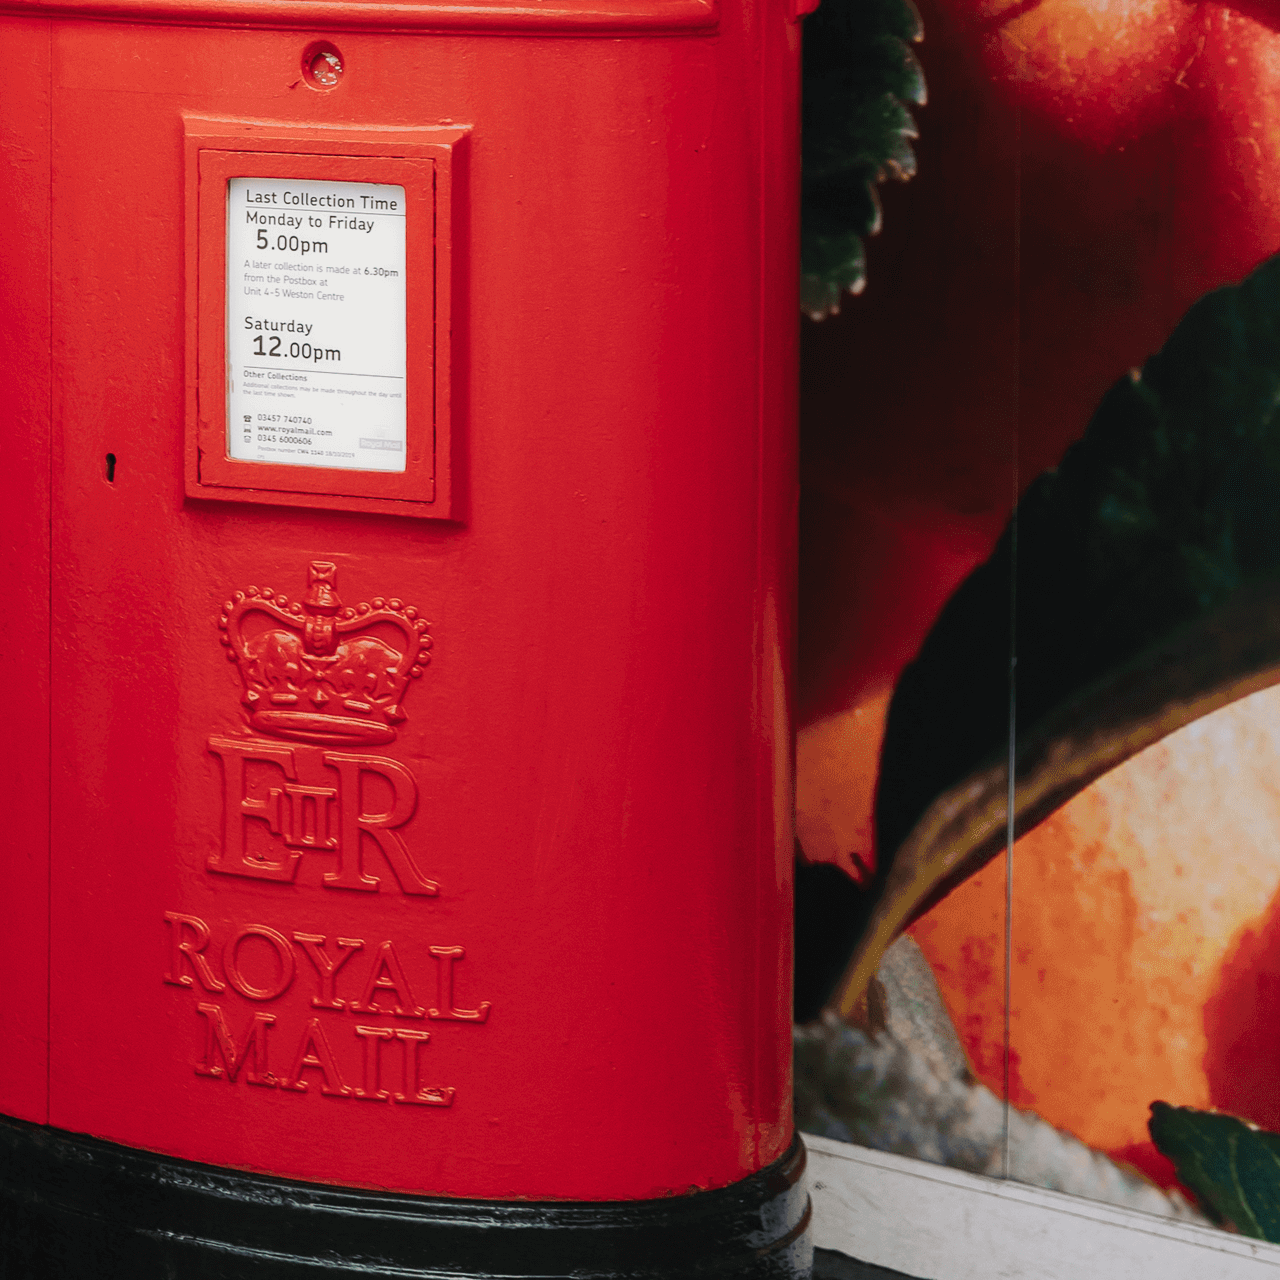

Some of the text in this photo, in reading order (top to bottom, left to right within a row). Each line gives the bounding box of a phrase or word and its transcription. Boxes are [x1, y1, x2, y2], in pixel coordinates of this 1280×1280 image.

[246, 189, 398, 210] Last Collection Time
[246, 211, 375, 233] Monday to Friday
[256, 229, 328, 255] 5.00pm
[244, 260, 399, 278] A later collection is made at 6.30pm
[244, 273, 328, 287] from the Postbox at
[244, 286, 345, 301] Unit 4-5 Weston Centre
[244, 316, 313, 336] Saturday
[253, 335, 341, 363] 12.00pm
[243, 370, 308, 382] Other Collections
[257, 414, 312, 425] 03457 740740
[257, 425, 333, 436] www.royalmail.com
[257, 434, 313, 445] 0345 6000606
[163, 909, 493, 1025] ROYAL
[194, 1001, 458, 1109] MAIL
